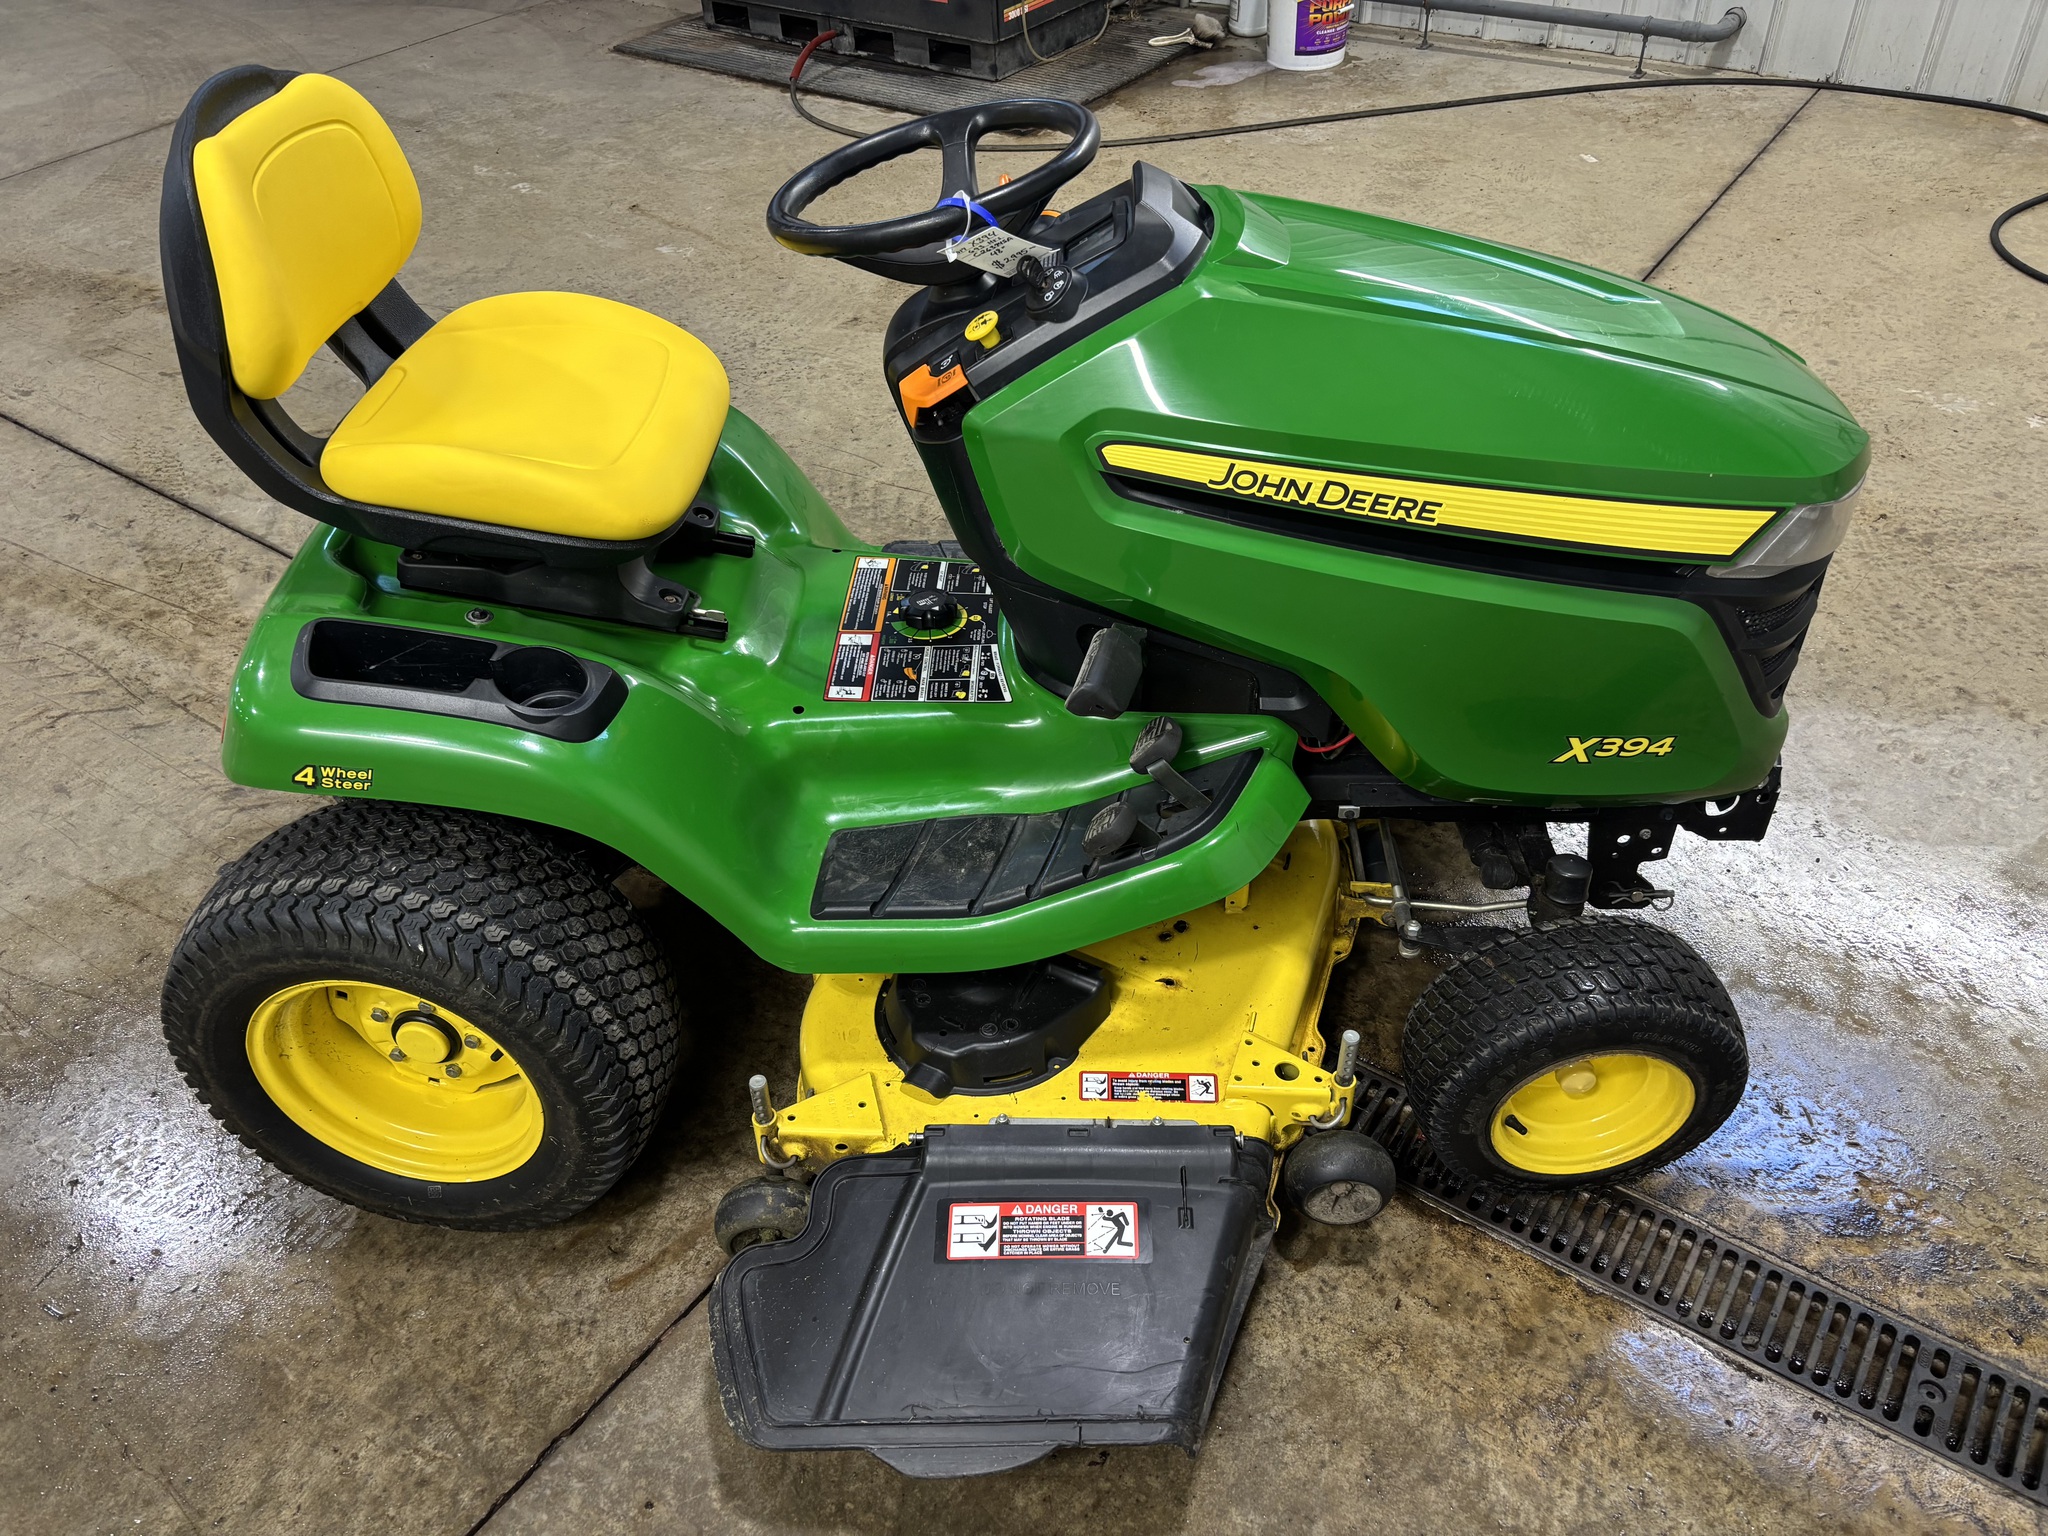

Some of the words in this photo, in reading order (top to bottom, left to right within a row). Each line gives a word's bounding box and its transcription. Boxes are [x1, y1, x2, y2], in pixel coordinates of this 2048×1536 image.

[970, 231, 997, 247] X394
[1208, 463, 1313, 501] JOHN
[1317, 480, 1444, 523] DEERE
[1550, 736, 1677, 763] X394
[294, 766, 315, 786] 4
[320, 766, 372, 780] Wheel
[321, 778, 371, 790] Steer
[1026, 1205, 1078, 1214] DANGER
[1050, 1282, 1121, 1296] REMOVE
